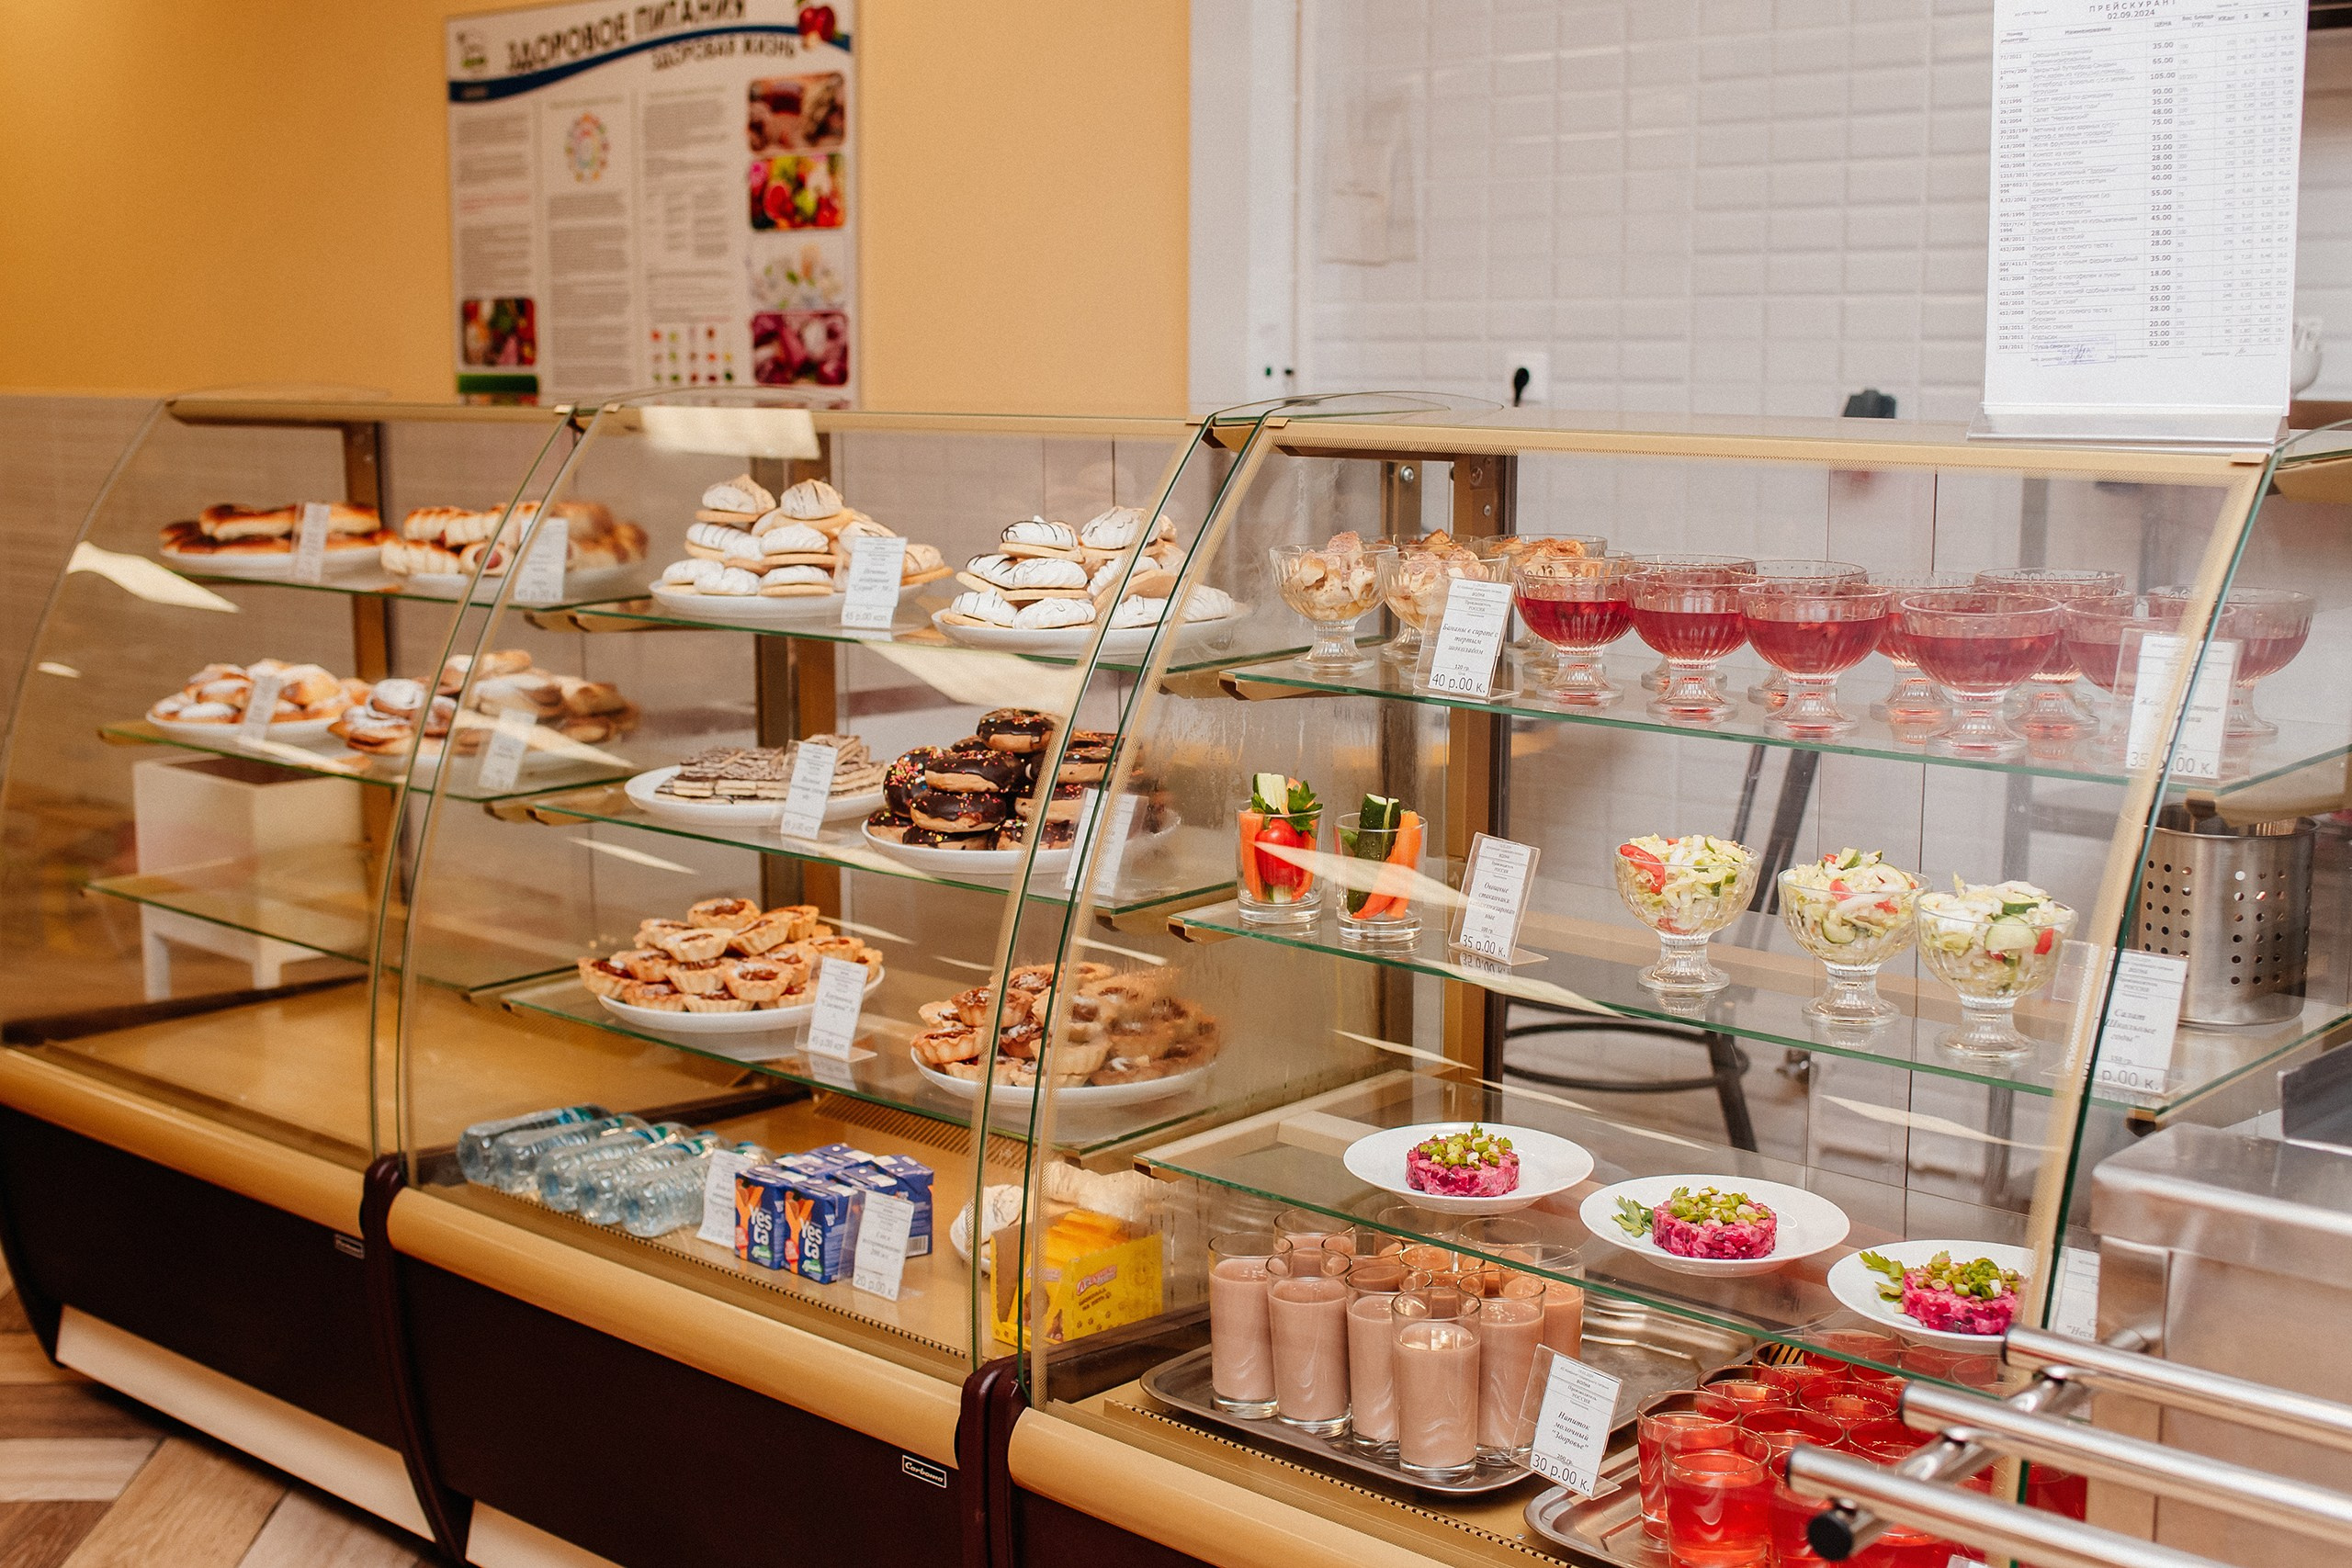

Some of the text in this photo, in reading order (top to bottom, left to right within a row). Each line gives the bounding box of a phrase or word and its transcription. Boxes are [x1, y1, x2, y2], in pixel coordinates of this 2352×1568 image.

[2108, 9, 2155, 20] 02.09.2024
[2150, 72, 2176, 80] 105.00
[2151, 239, 2172, 247] 28.00
[1442, 624, 1466, 634] Бананы
[1472, 629, 1494, 638] сиропе
[1454, 637, 1482, 645] тертым
[1448, 645, 1484, 655] шоколадом
[1432, 674, 1486, 693] 40 р.00 к.
[1484, 882, 1509, 894] Овощные
[1478, 892, 1510, 903] стаканчики
[1463, 934, 1473, 948] 35
[1498, 947, 1506, 957] к.
[2114, 1009, 2145, 1021] Салат
[2145, 1078, 2159, 1090] к.
[749, 1204, 773, 1231] Yes
[799, 1217, 823, 1245] Yes
[1558, 1411, 1590, 1430] Напиток
[1554, 1422, 1589, 1441] молочный
[1552, 1429, 1589, 1450] "Здоровье"
[905, 1461, 944, 1482] Carboma
[1532, 1453, 1589, 1492] 30 р.00 к.
